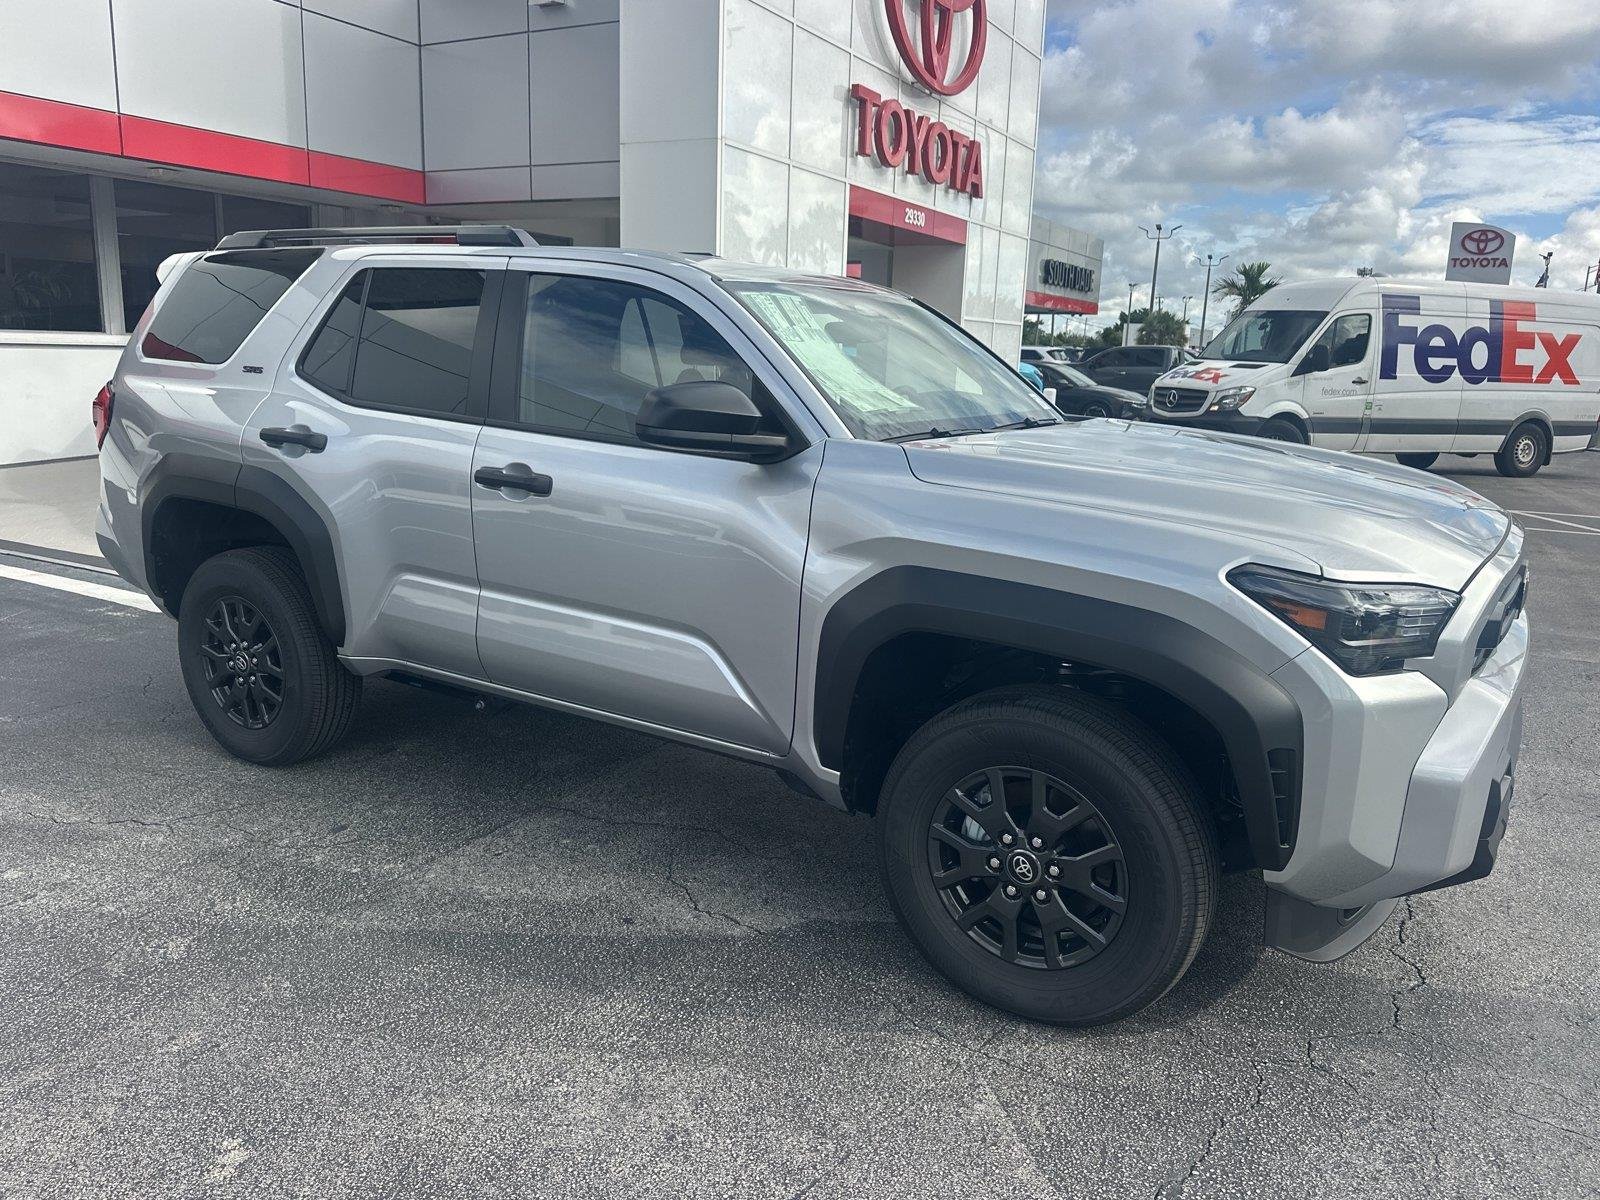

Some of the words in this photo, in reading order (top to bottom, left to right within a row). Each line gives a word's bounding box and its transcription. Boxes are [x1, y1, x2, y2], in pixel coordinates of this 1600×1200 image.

[851, 83, 984, 199] TOYOTA
[904, 207, 926, 228] 29330
[1044, 259, 1076, 289] SOUTH
[1075, 264, 1095, 293] DADE
[1450, 257, 1509, 268] TOYOTA
[1379, 293, 1583, 386] FedEx
[1321, 386, 1358, 397] fedex.com
